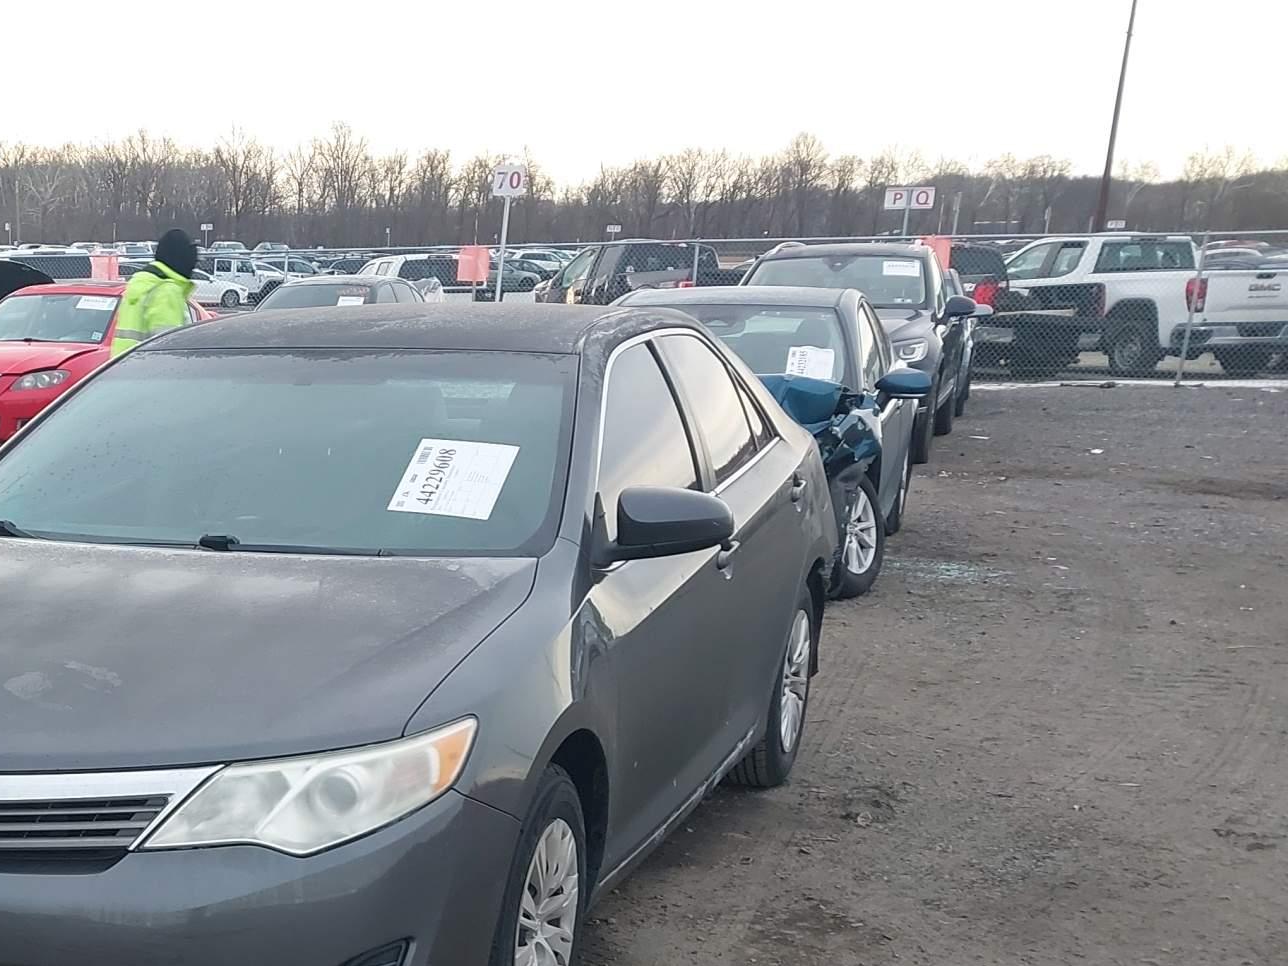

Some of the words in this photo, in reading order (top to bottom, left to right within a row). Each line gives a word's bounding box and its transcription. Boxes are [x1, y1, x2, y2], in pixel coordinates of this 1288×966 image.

[497, 171, 522, 189] 70
[893, 192, 904, 205] P
[916, 191, 930, 205] Q
[415, 448, 457, 505] 44229608
